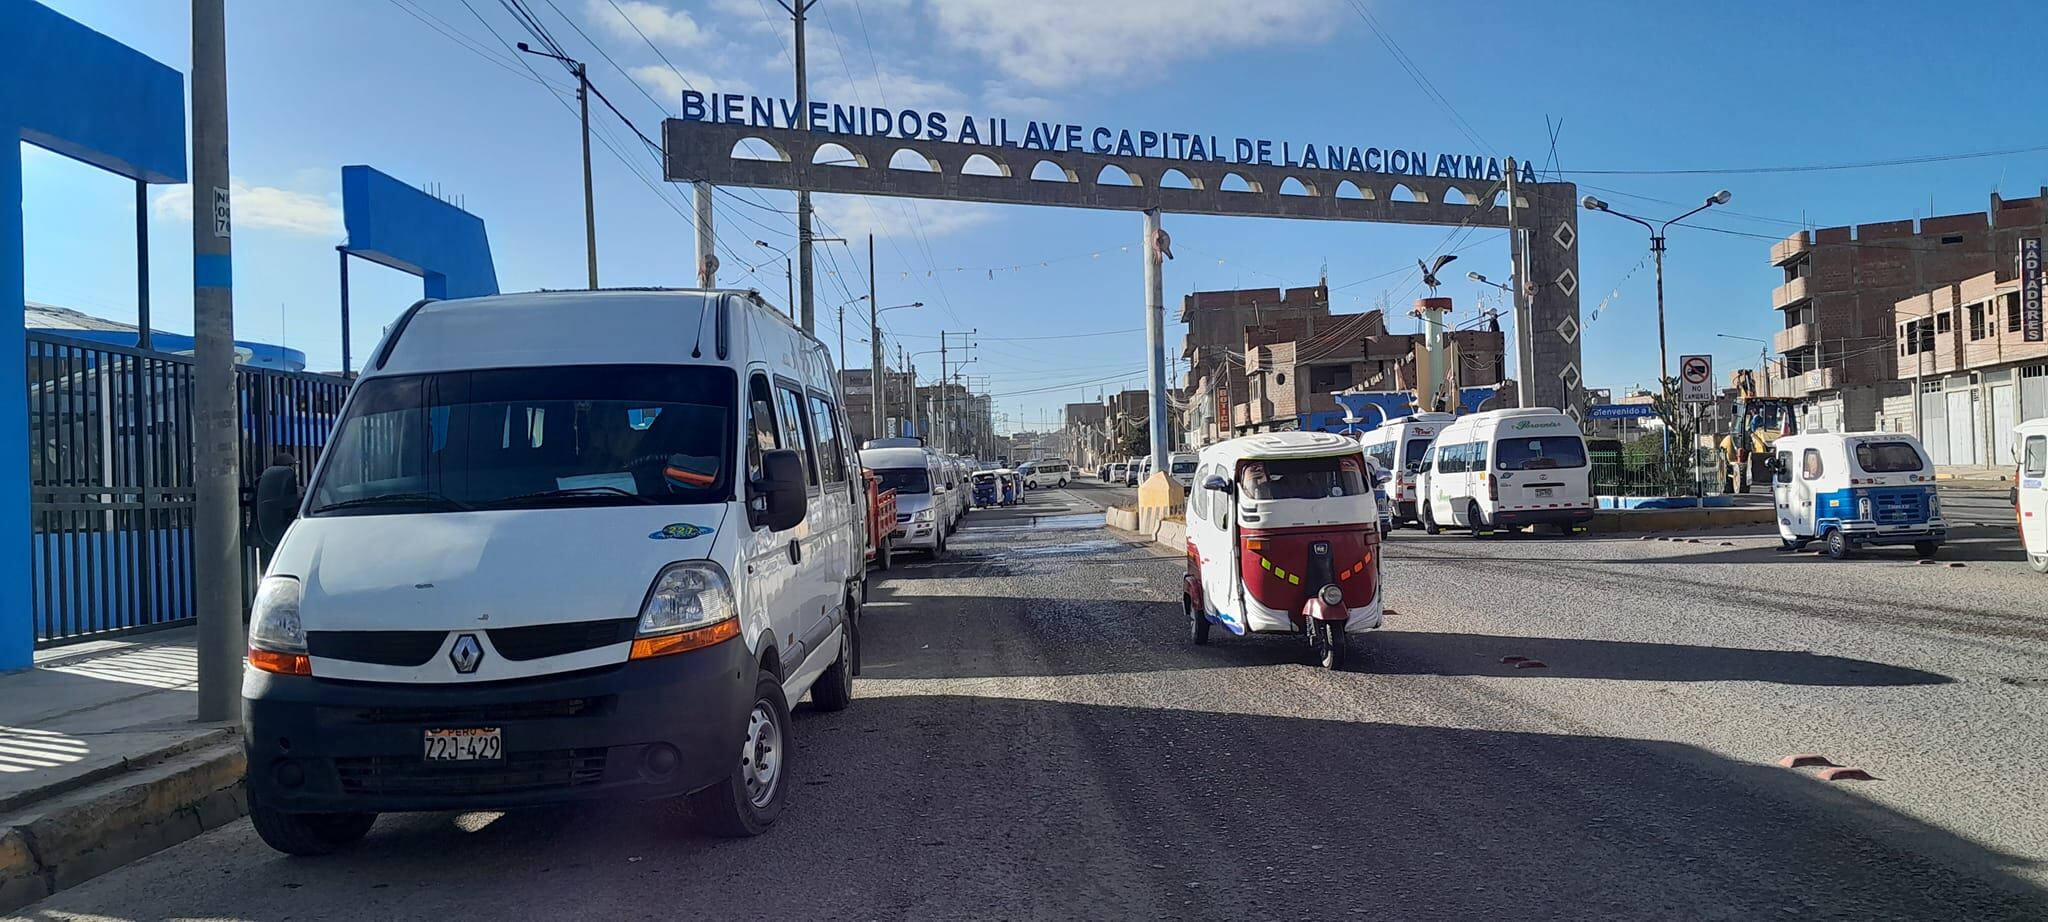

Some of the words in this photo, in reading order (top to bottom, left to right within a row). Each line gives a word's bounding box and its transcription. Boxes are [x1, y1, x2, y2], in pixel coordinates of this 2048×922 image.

[682, 90, 948, 142] BIENVENIDOS
[958, 116, 982, 145] A
[990, 118, 1082, 152] ILAVE
[1092, 127, 1227, 161] CAPITAL
[1235, 138, 1273, 165] DE
[1283, 142, 1320, 169] LA
[1327, 145, 1427, 176] NACION
[2025, 239, 2040, 340] RADIADORES
[425, 735, 500, 760] Z2J-429
